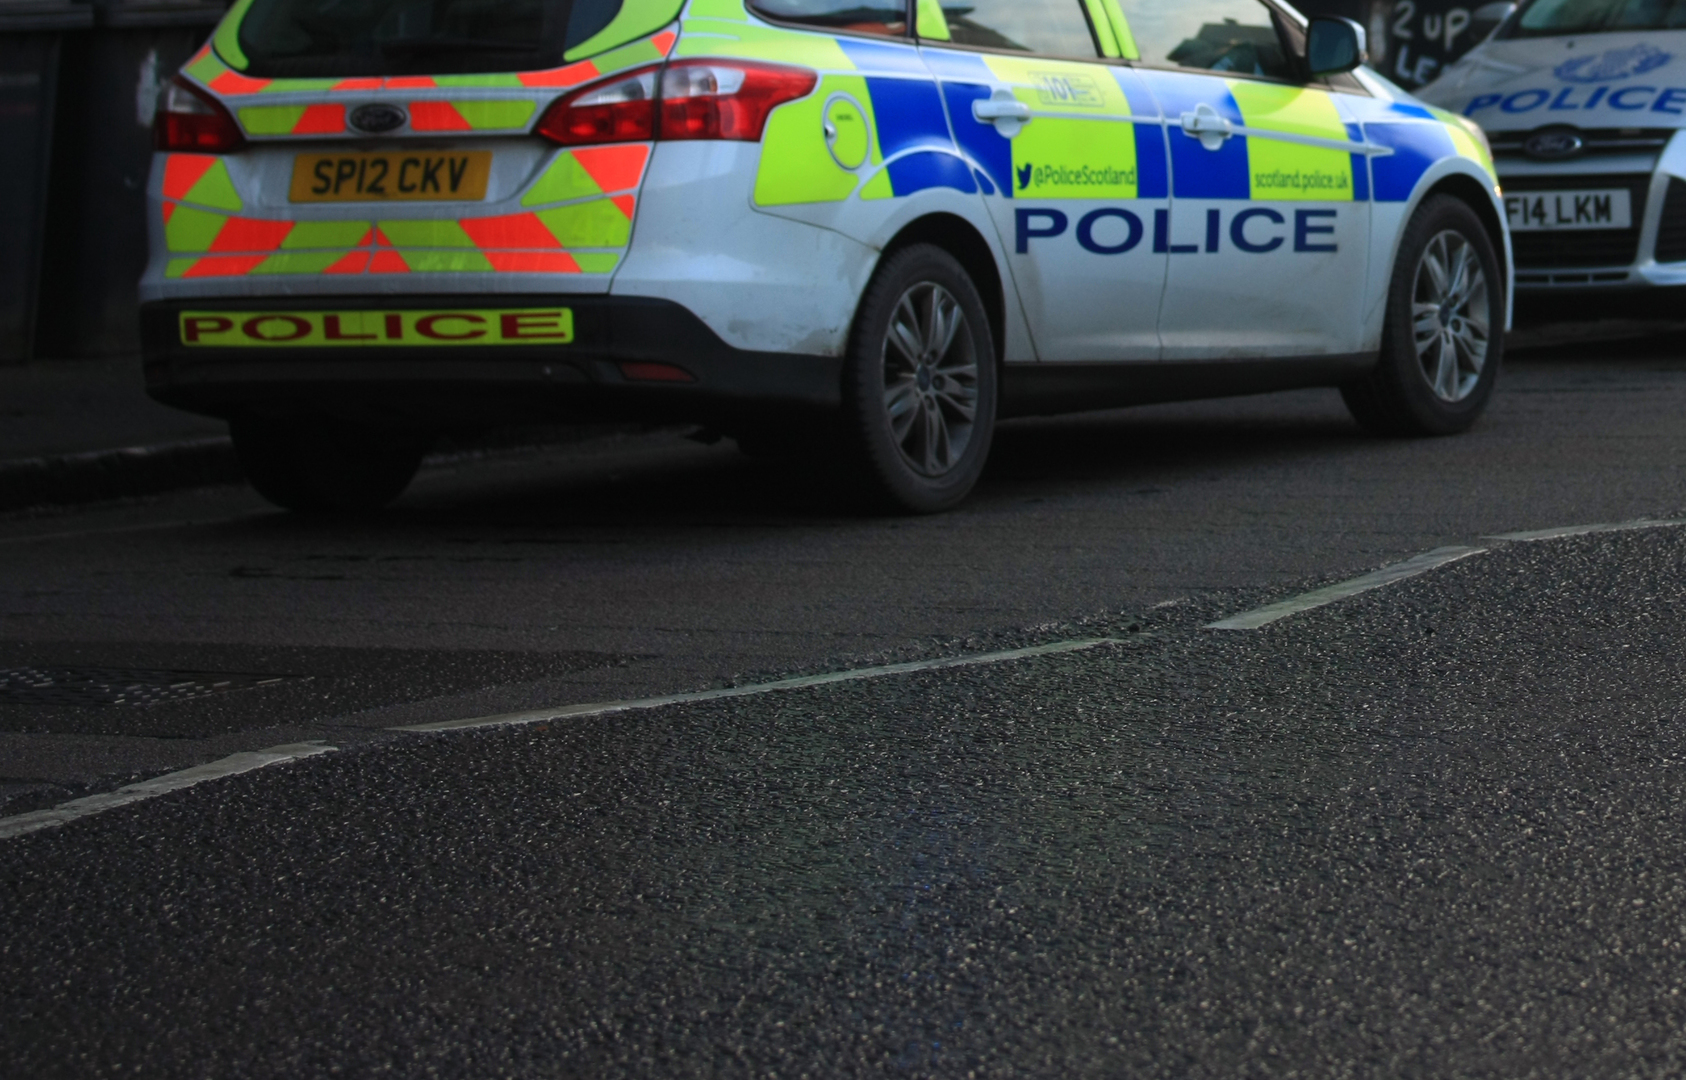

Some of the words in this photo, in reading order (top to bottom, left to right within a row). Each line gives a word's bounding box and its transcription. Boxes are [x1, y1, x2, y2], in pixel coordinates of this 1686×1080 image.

[1393, 0, 1415, 38] 2
[1043, 76, 1077, 101] 101
[311, 158, 390, 195] SP12
[398, 156, 469, 194] CKV
[1034, 164, 1136, 188] @PoliceScotland
[1254, 169, 1349, 194] scotland.police.uk
[1505, 196, 1548, 226] F14
[1556, 193, 1613, 224] LKM
[1014, 207, 1338, 255] POLICE
[183, 311, 567, 343] POLICE
